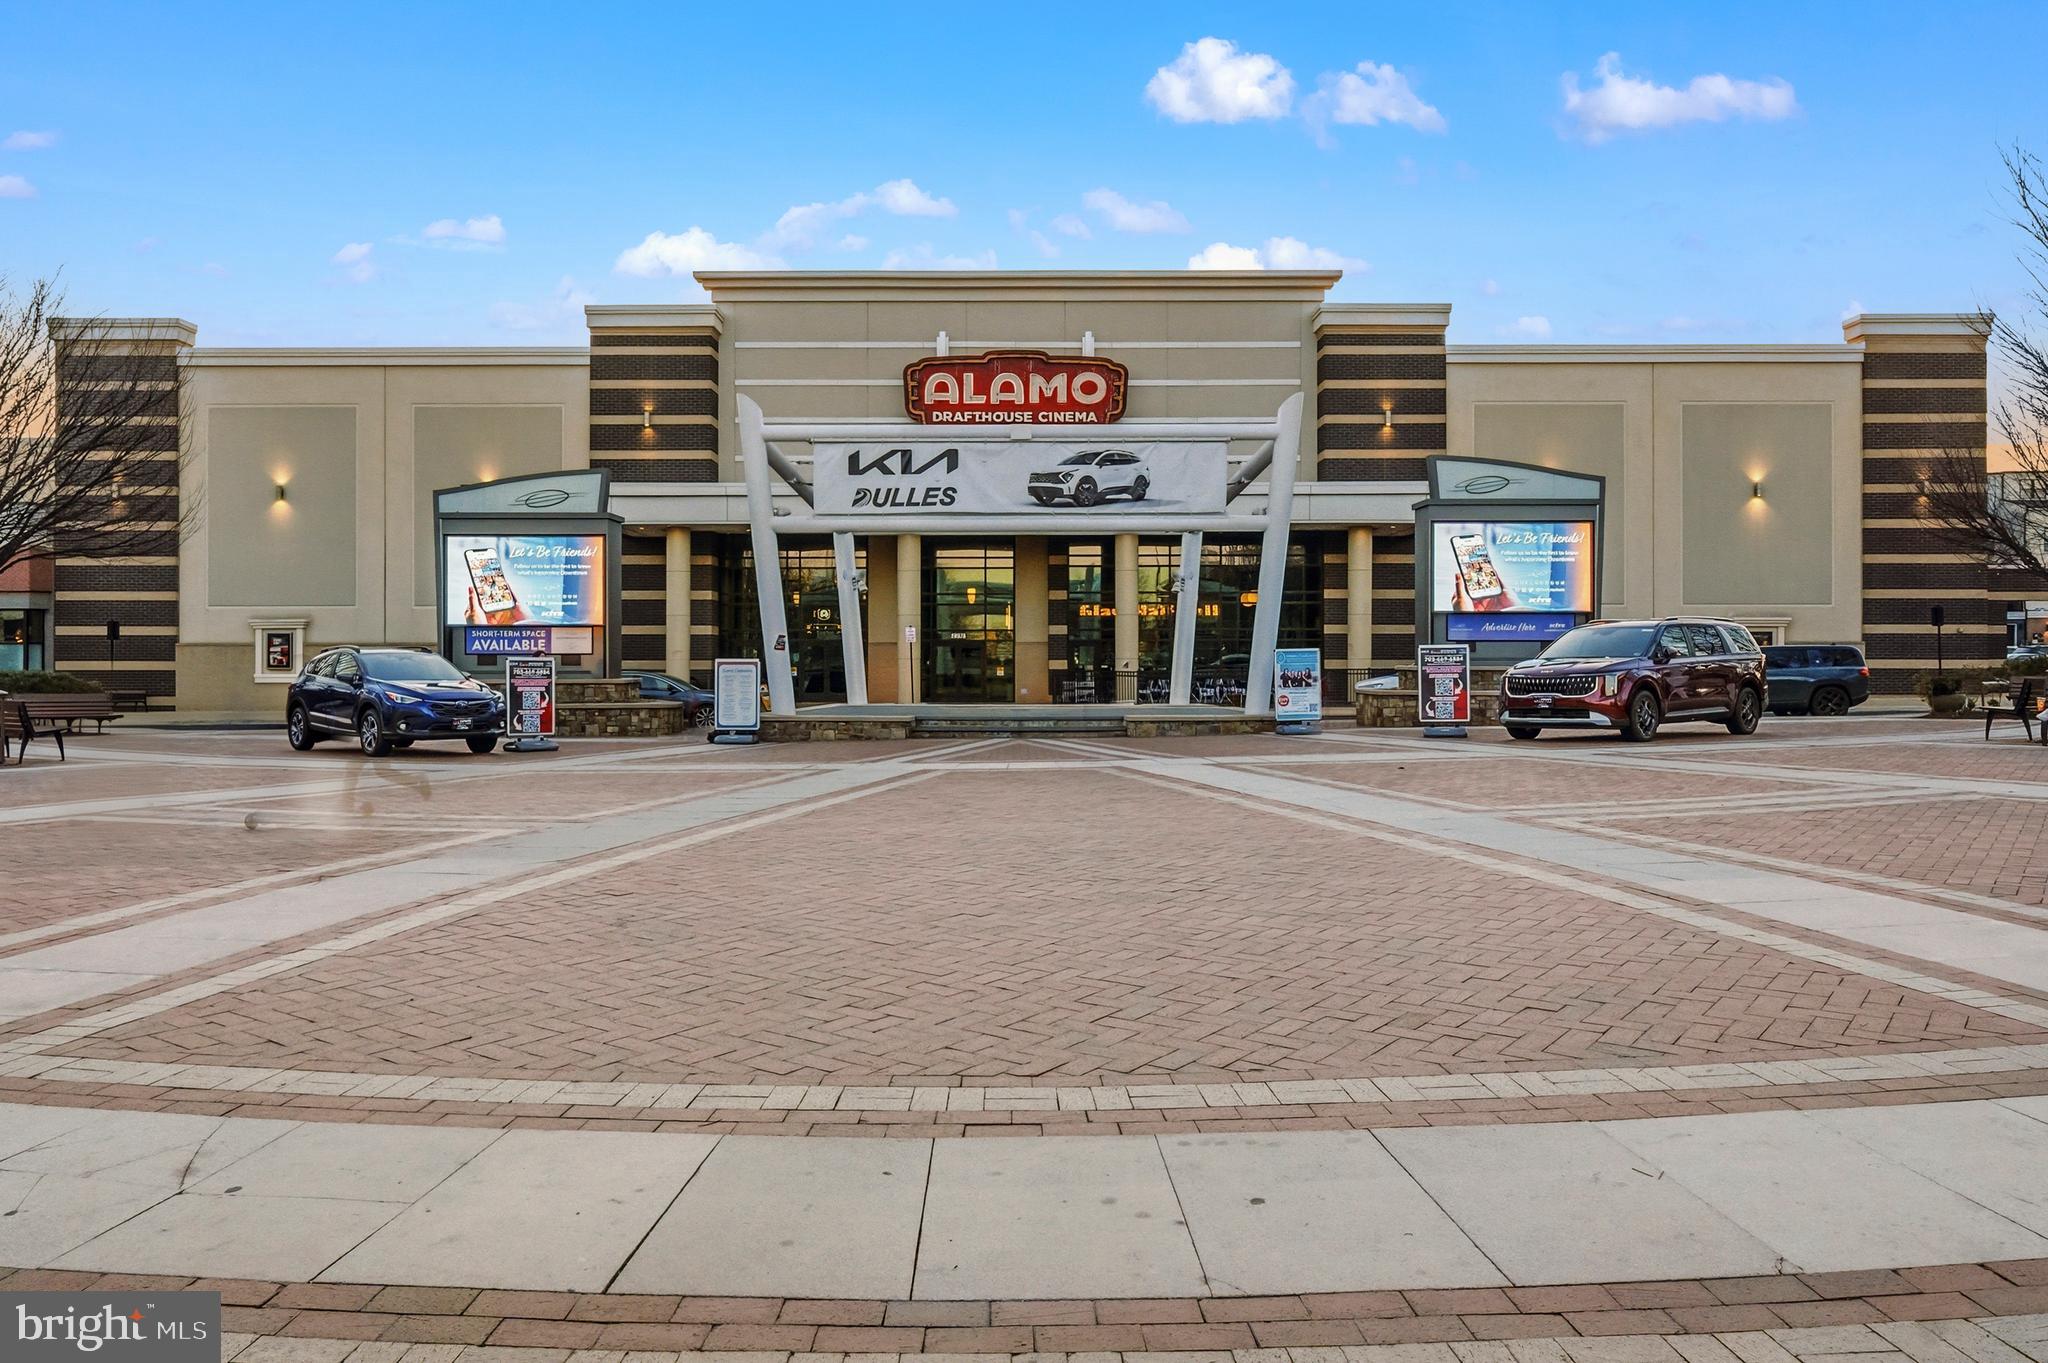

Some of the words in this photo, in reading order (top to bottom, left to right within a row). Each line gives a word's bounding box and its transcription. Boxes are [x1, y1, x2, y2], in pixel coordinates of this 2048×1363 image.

[924, 372, 1107, 405] ALAMO
[932, 411, 1033, 423] DRAFTHOUSE
[1038, 411, 1097, 423] CINEMA
[848, 449, 958, 475] KIA
[852, 487, 958, 508] DULLES
[1496, 533, 1521, 545] Let's
[1523, 532, 1538, 545] Be
[1541, 532, 1585, 545] Friends!
[509, 545, 535, 558] Let's
[536, 545, 551, 558] Be
[553, 545, 598, 558] Friends!
[1481, 622, 1517, 632] Advertise
[471, 639, 546, 651] AVAILABLE
